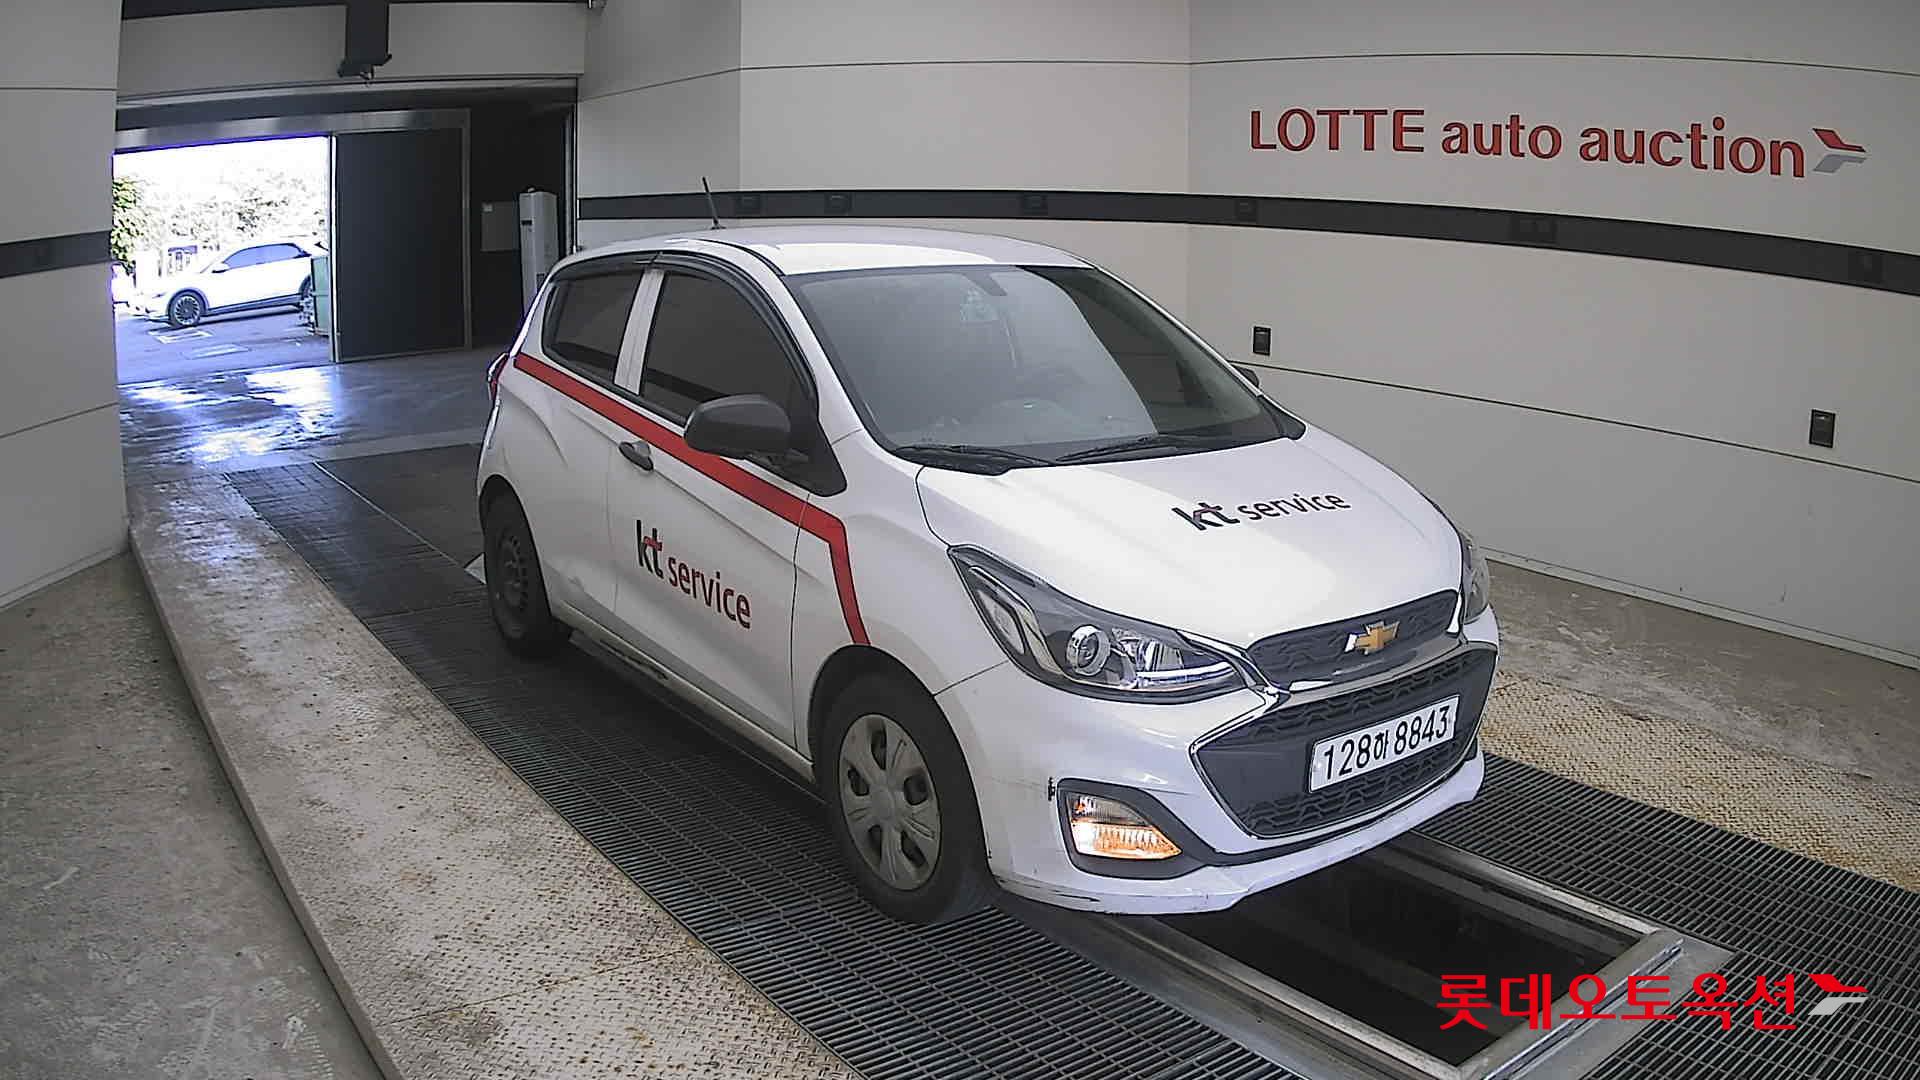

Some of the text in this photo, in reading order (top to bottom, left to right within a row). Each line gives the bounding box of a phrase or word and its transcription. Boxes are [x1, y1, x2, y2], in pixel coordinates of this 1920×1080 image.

[1251, 109, 1804, 178] LOTTE auto auction
[1171, 493, 1351, 531] kt service
[636, 519, 750, 629] kt service
[1394, 705, 1450, 755] 8843
